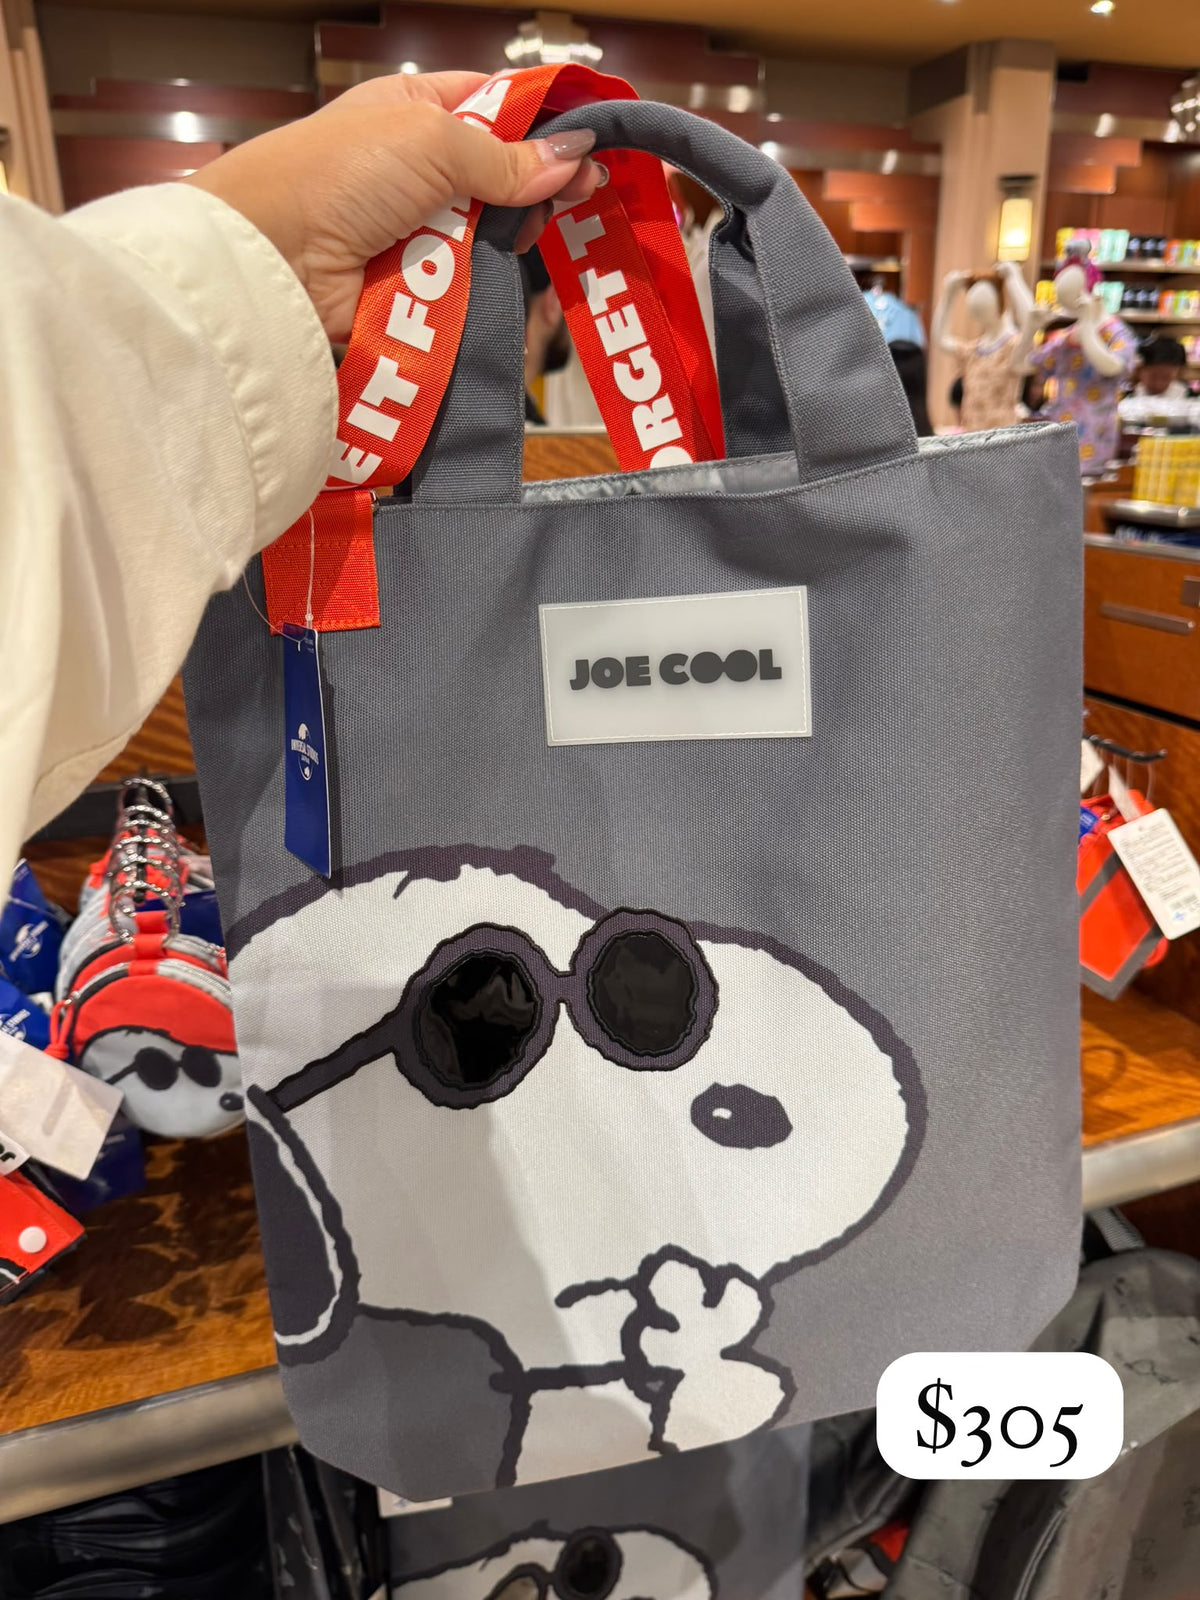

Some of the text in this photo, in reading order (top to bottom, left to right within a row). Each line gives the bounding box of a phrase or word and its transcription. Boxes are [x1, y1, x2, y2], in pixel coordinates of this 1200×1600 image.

[345, 354, 421, 443] IT
[569, 648, 782, 691] JOE COOL
